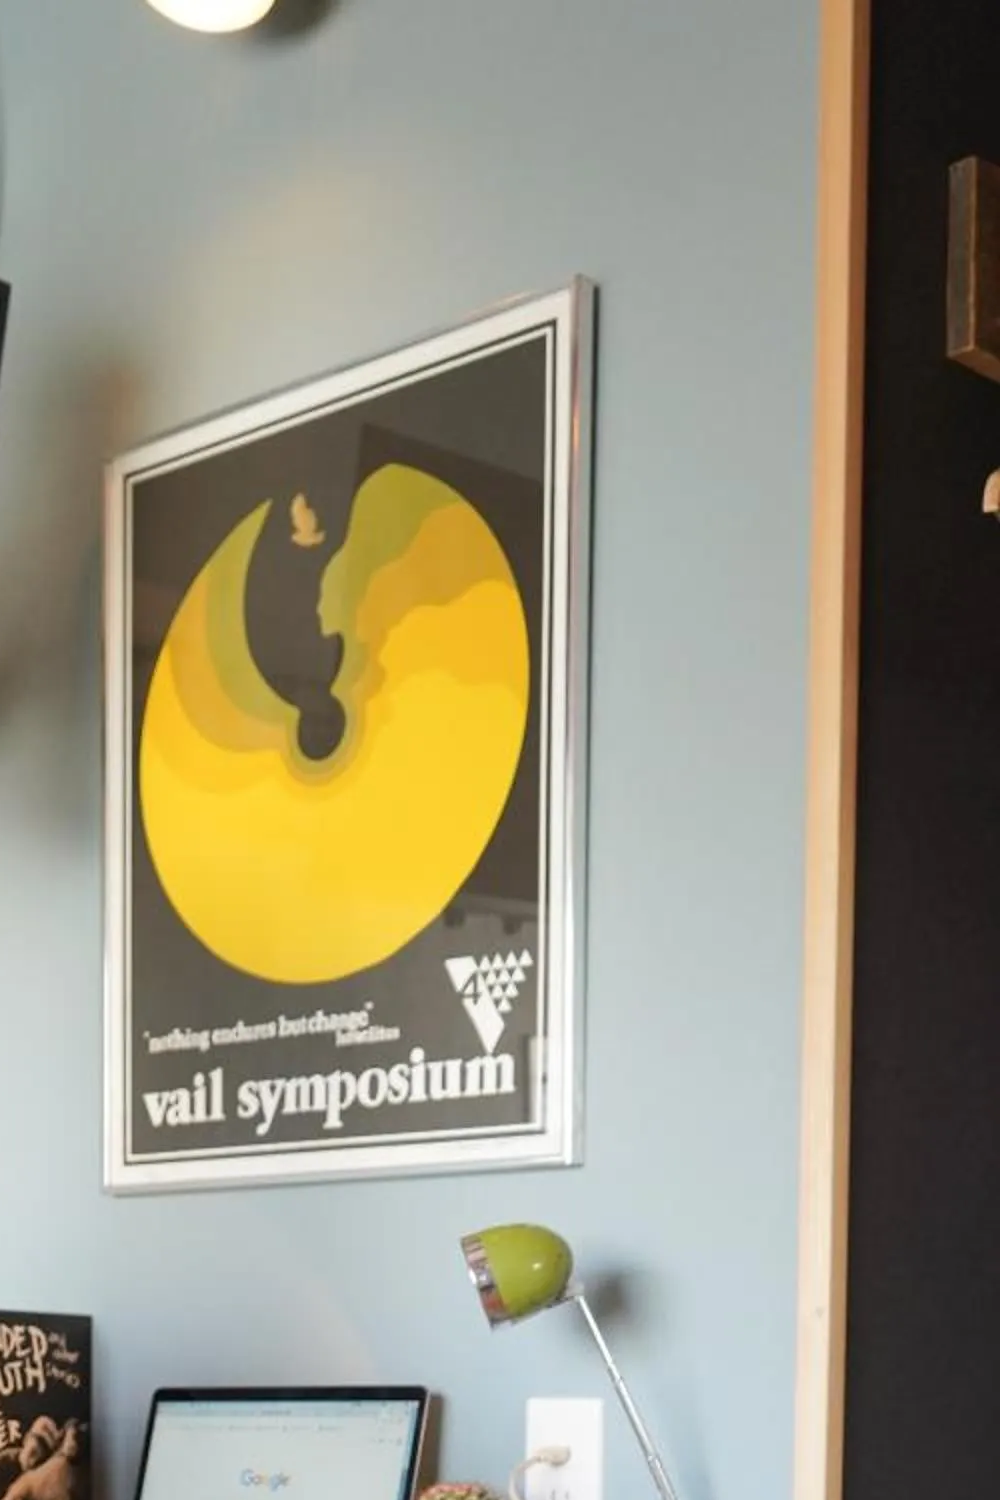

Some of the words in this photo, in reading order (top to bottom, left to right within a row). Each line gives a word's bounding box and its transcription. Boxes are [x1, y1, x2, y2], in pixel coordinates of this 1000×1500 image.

[142, 1067, 226, 1128] vail
[236, 1046, 517, 1137] symposium
[239, 1467, 292, 1492] Google
